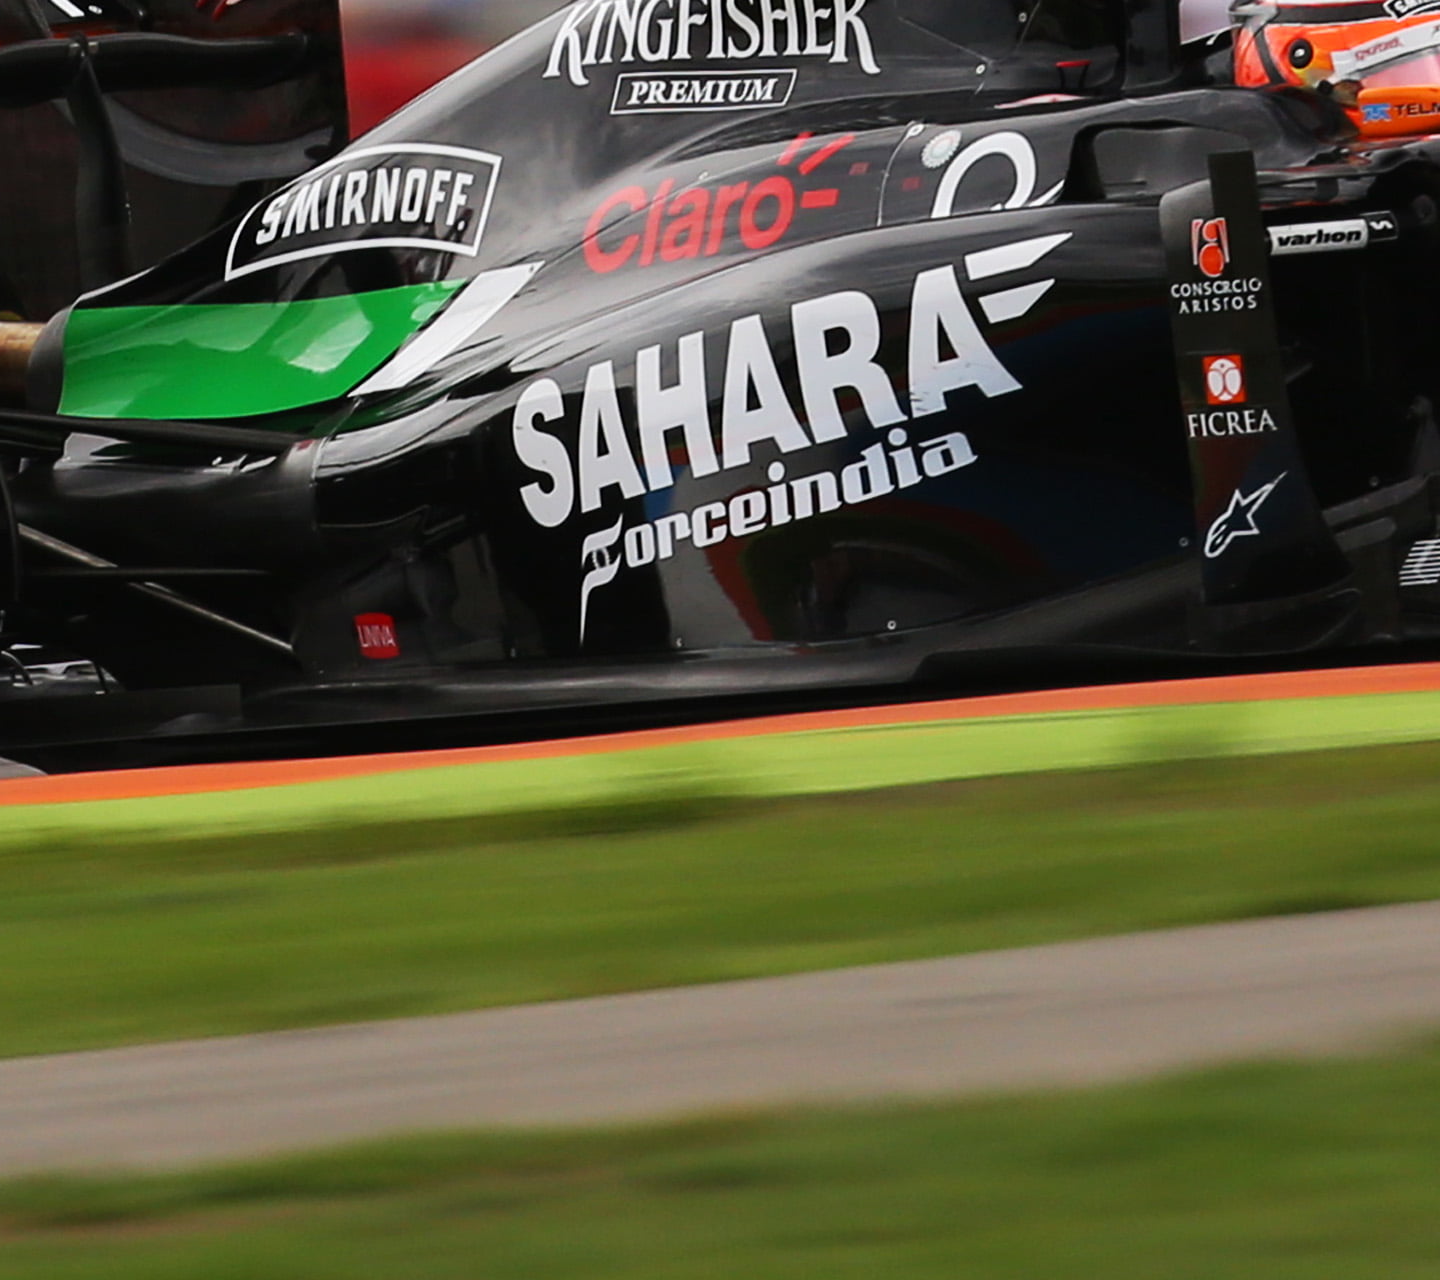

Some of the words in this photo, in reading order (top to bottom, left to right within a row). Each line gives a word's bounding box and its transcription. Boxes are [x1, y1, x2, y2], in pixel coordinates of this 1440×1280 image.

[625, 77, 781, 108] PREMIUM
[582, 175, 796, 274] Claro
[1170, 277, 1263, 299] CONSORCIO
[1178, 294, 1258, 315] ARISTOS
[512, 264, 1023, 528] SAHARA
[1186, 408, 1278, 439] FICREA
